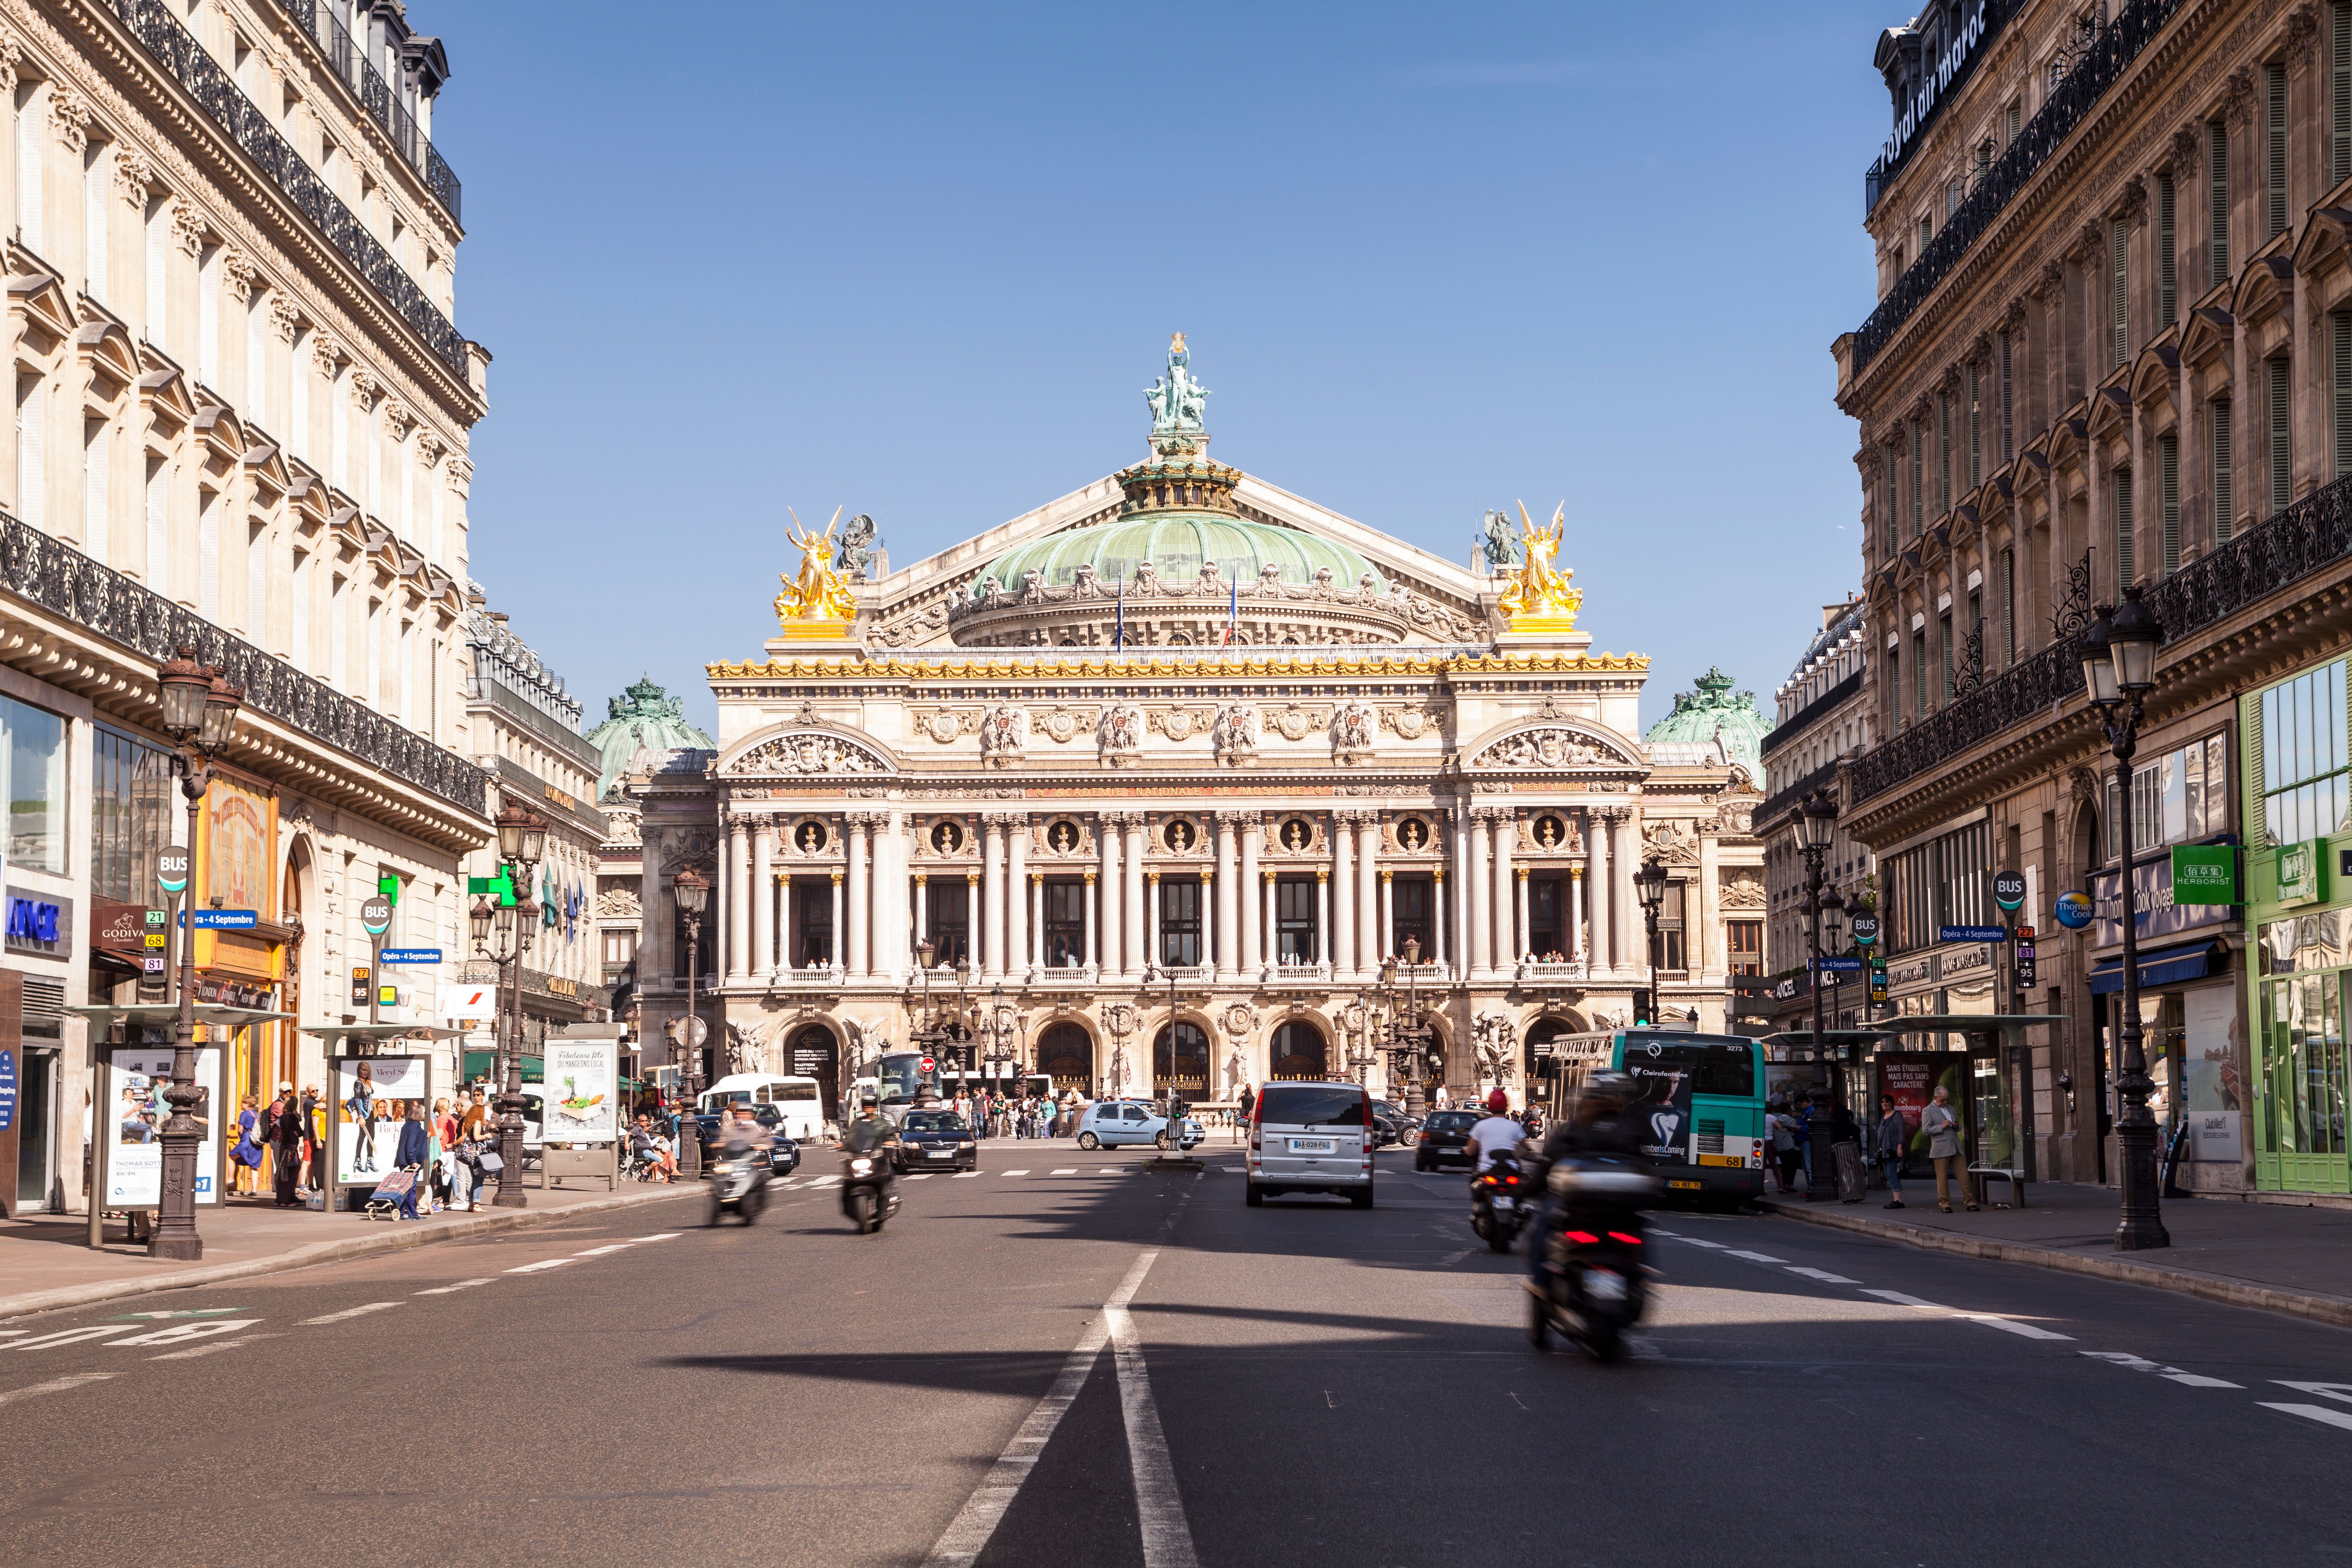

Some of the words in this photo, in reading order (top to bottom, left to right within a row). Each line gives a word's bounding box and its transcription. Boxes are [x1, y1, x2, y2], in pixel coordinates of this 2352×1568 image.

[1880, 98, 1915, 174] royal
[1918, 72, 1936, 122] air
[1939, 0, 1986, 95] maroc
[942, 720, 949, 729] N
[1001, 719, 1007, 727] E
[1060, 720, 1066, 728] N
[1551, 782, 1583, 791] LYRIQUE
[1055, 788, 1123, 797] ACADEMIE
[1135, 787, 1201, 796] NATIONALE
[1213, 787, 1230, 796] DE
[1242, 786, 1304, 795] MUSIQUE
[160, 856, 187, 871] BUS
[2188, 867, 2219, 876] 佰草集
[1998, 880, 2022, 892] BUS
[2133, 886, 2151, 914] Cook
[2058, 902, 2092, 910] Thomas
[365, 906, 388, 918] BUS
[150, 913, 161, 922] 21
[209, 916, 214, 924] 4
[215, 915, 253, 926] Septembre
[1855, 920, 1875, 930] BUS
[102, 929, 145, 938] GODIVA
[1942, 930, 1961, 939] Opéra
[1971, 930, 2003, 939] Septembre
[2019, 928, 2032, 937] 27
[148, 936, 162, 945] 68
[382, 952, 400, 961] Opéra
[409, 952, 439, 961] Septembre
[148, 959, 160, 969] 81
[201, 985, 217, 998] LONDON
[355, 988, 366, 996] 95
[592, 1051, 604, 1059] fête
[376, 1068, 395, 1078] Meryl
[1643, 1070, 1688, 1078] Clairefontaine
[1298, 1140, 1326, 1149] AA-028-FG
[1726, 1157, 1739, 1166] 68
